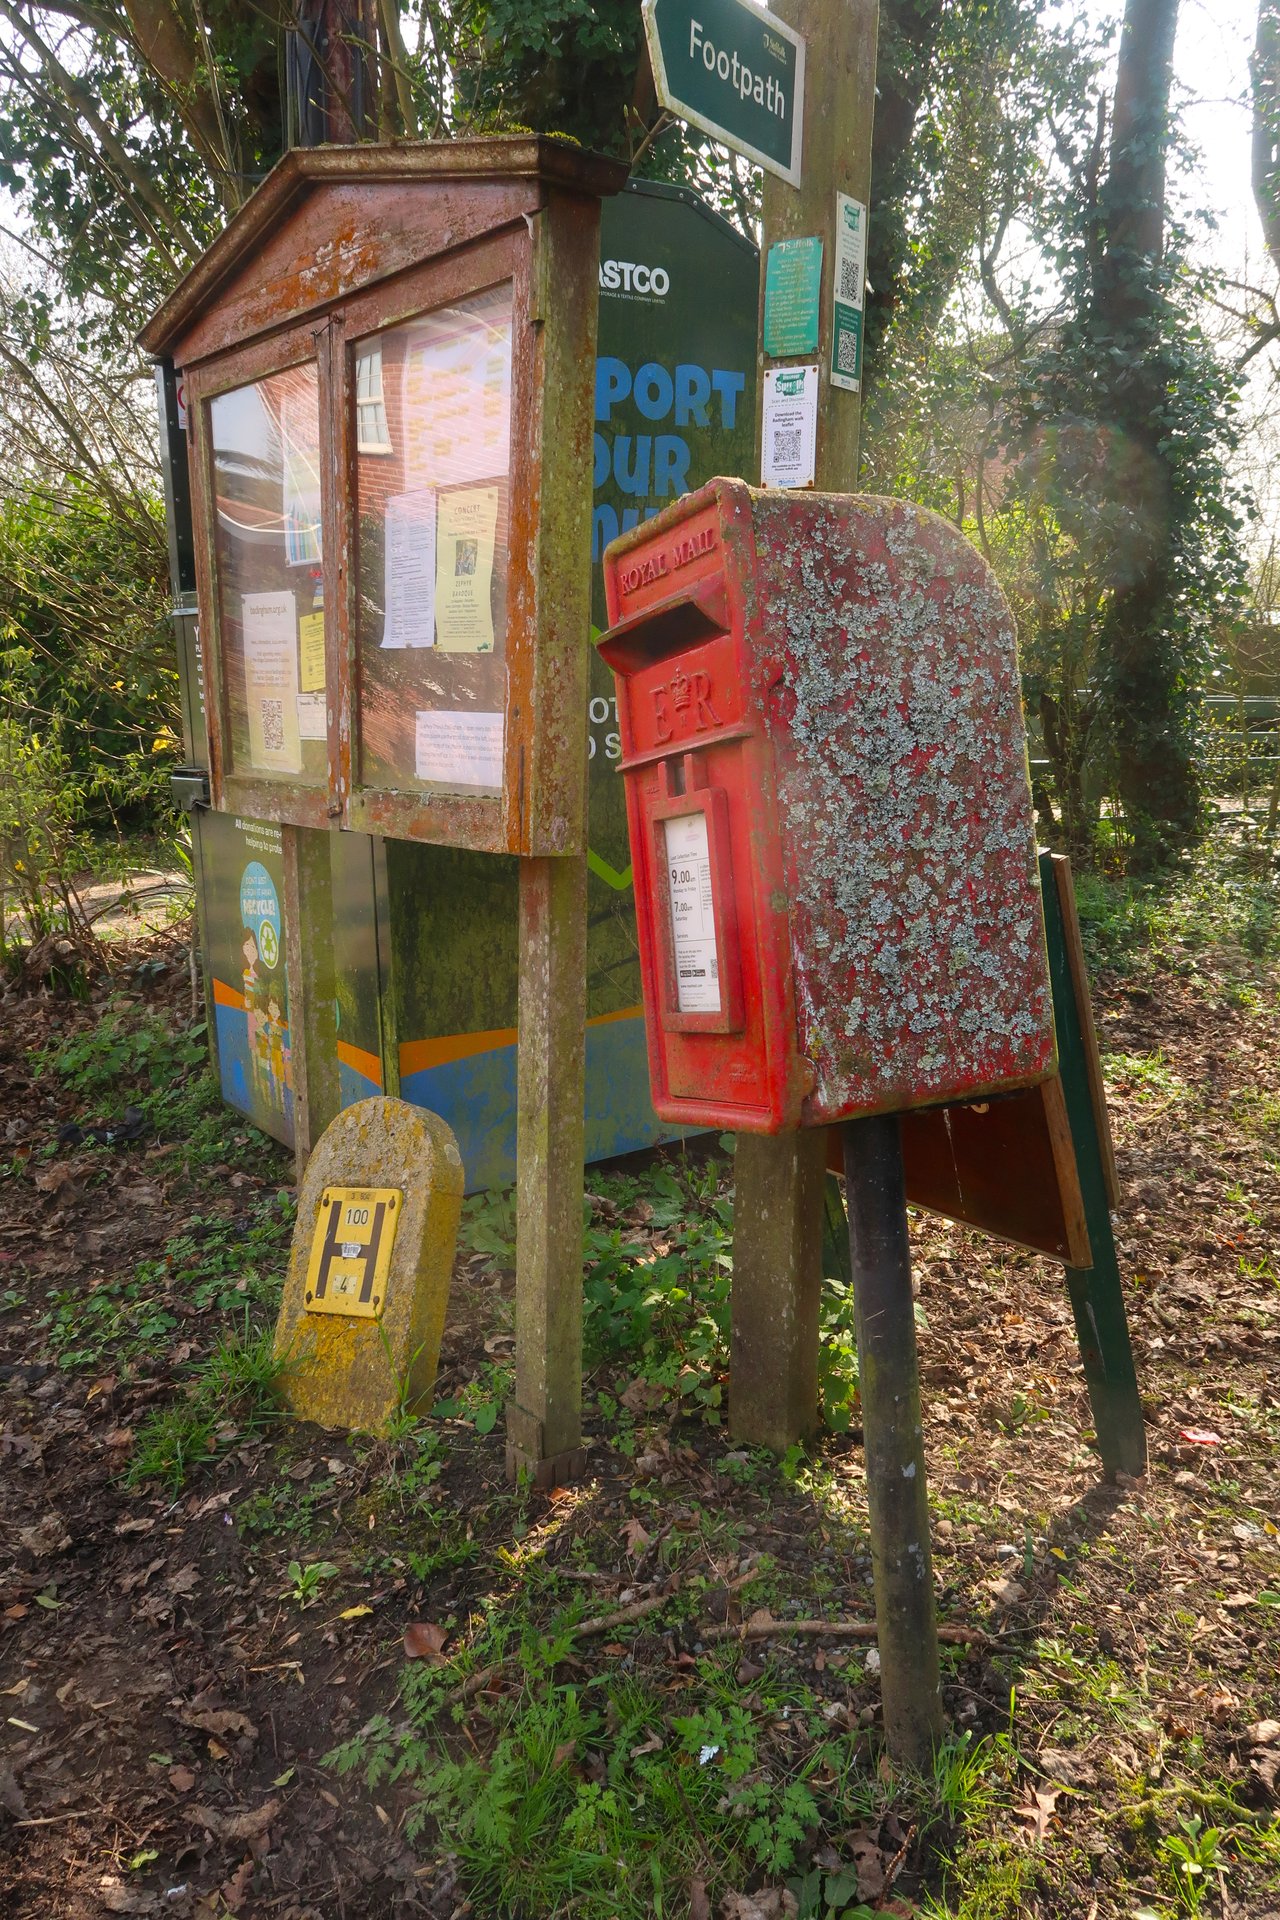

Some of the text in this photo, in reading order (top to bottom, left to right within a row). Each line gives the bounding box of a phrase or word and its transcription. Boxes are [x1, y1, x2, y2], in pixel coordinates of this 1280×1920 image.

[689, 18, 785, 119] Footpath
[454, 504, 481, 515] CONCERT
[620, 554, 672, 596] ROYAL
[672, 528, 719, 570] MAIL
[242, 820, 265, 836] donations
[264, 828, 274, 838] are
[245, 836, 263, 852] helping
[347, 1208, 369, 1225] 100
[340, 1276, 348, 1293] 4
